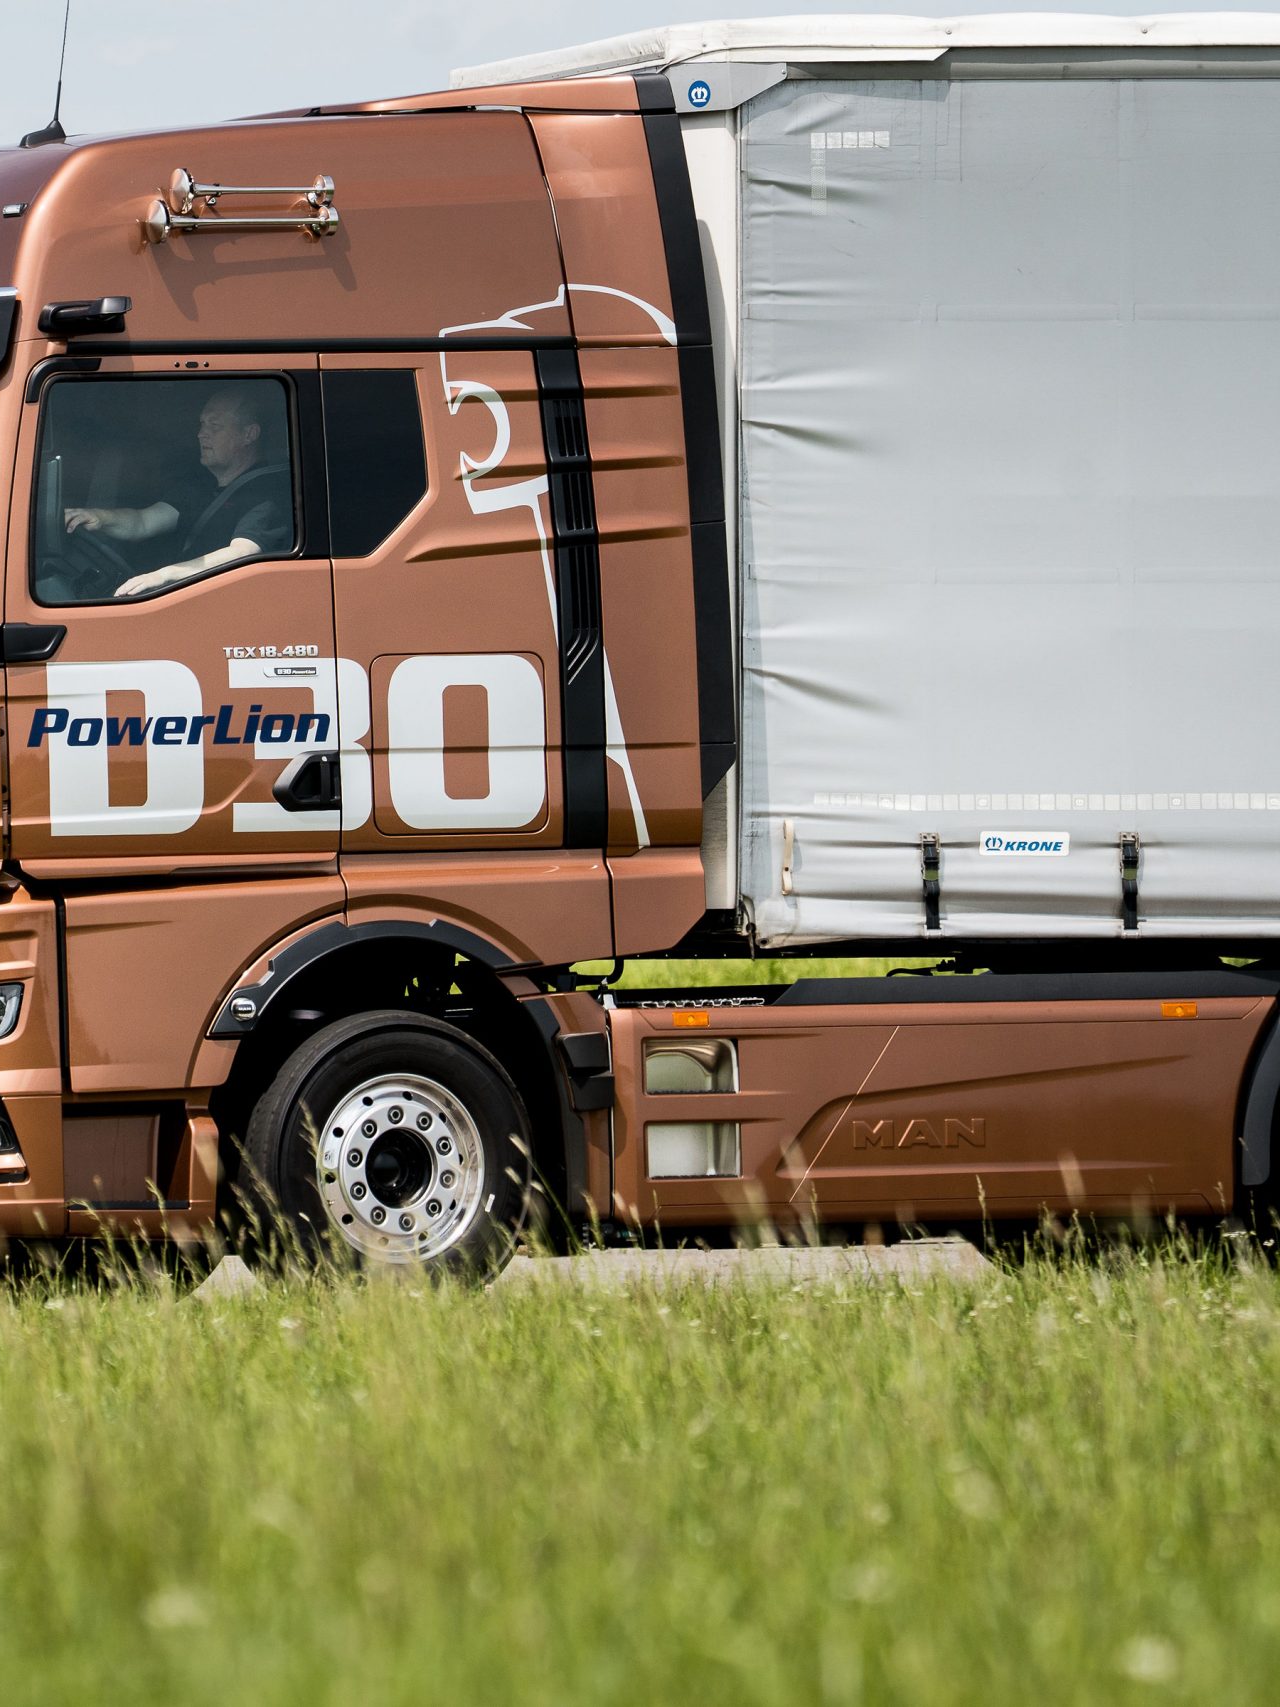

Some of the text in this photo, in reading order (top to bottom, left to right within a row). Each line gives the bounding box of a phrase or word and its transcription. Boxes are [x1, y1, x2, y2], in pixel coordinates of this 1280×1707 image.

[223, 645, 319, 659] TGX 18.480
[27, 704, 331, 747] PowerLion
[46, 655, 546, 837] D30
[1004, 841, 1064, 852] KRONE
[852, 1118, 986, 1150] MAN
